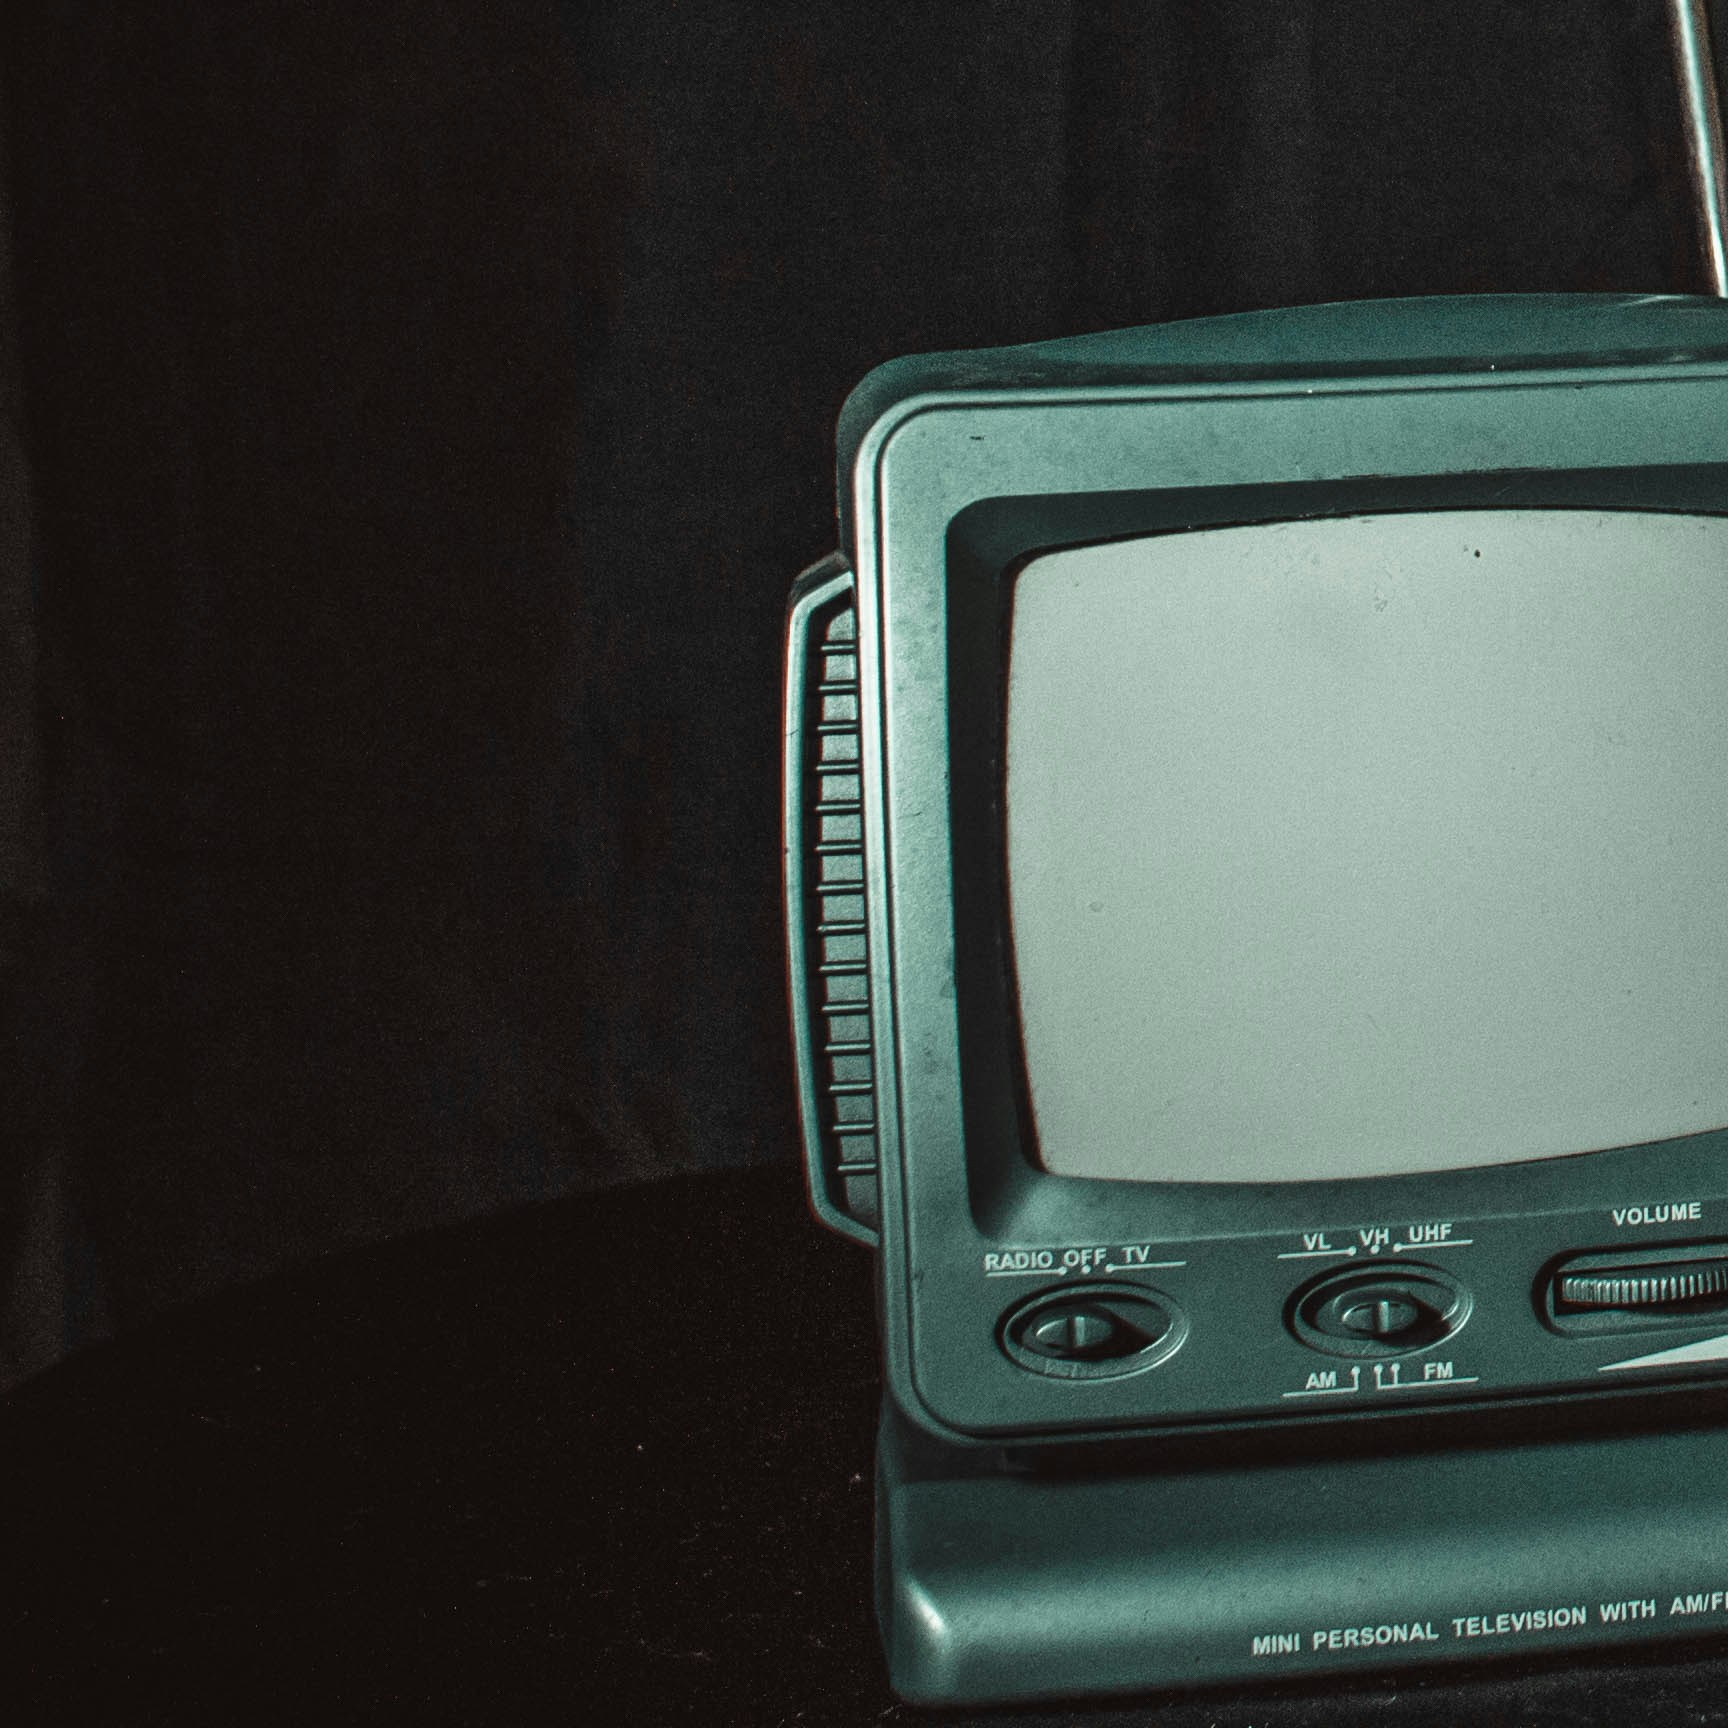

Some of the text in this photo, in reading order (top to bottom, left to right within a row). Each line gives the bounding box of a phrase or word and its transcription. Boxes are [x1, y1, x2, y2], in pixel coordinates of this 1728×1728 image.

[1612, 1202, 1702, 1227] VOLUME
[1303, 1223, 1453, 1251] VL VH UHF
[985, 1245, 1151, 1270] RADIO OFF TV
[1305, 1371, 1337, 1390] AM
[1424, 1362, 1454, 1381] FM
[1252, 1632, 1301, 1656] MINI
[1312, 1620, 1439, 1652] PERSONAL
[1452, 1606, 1587, 1637] TELEVISION
[1600, 1597, 1657, 1623] WITH
